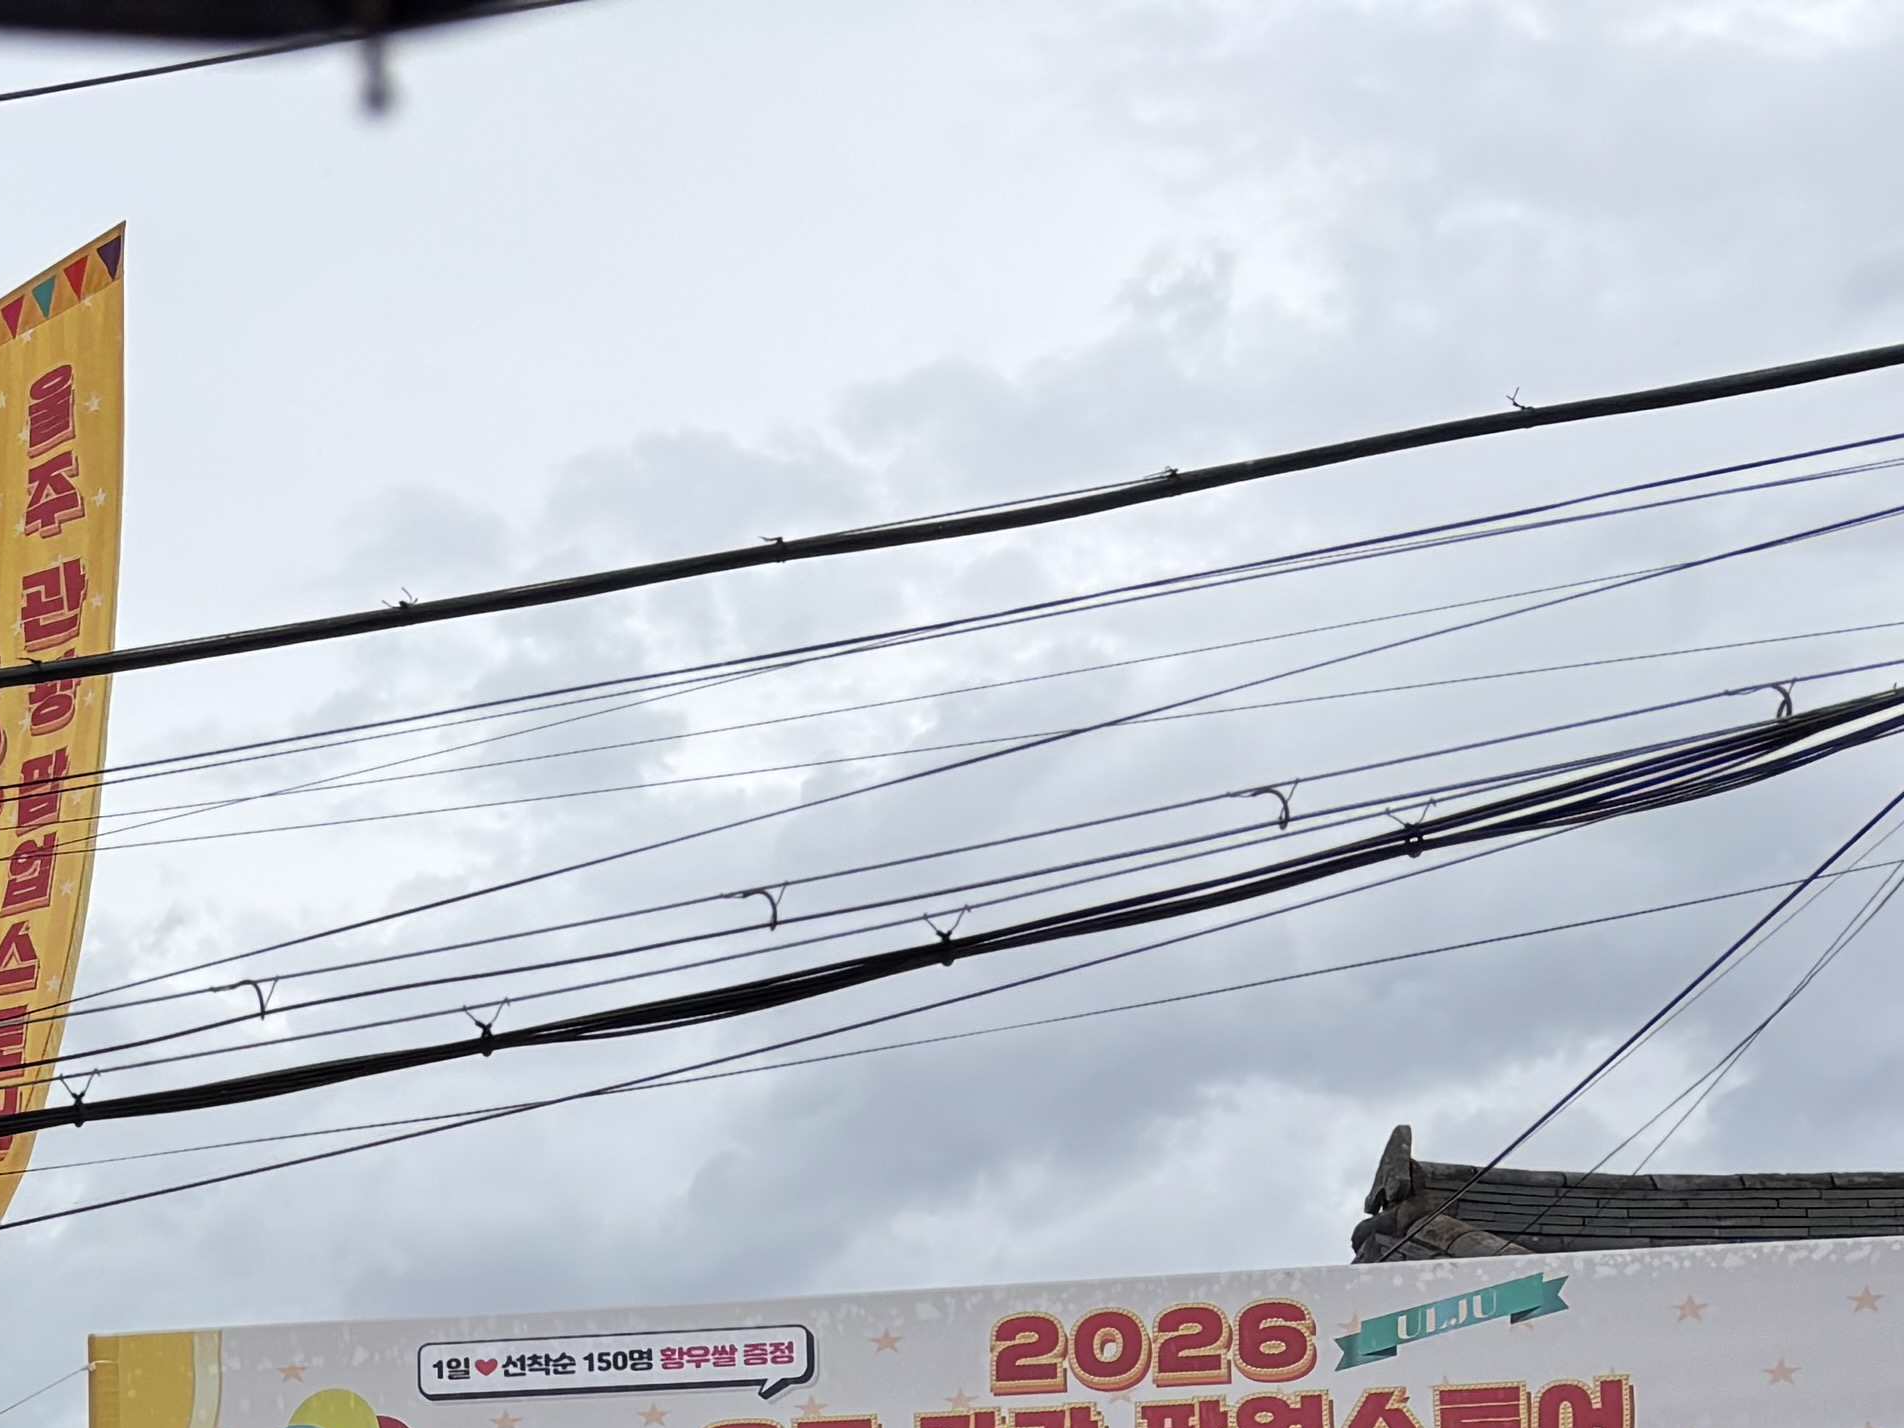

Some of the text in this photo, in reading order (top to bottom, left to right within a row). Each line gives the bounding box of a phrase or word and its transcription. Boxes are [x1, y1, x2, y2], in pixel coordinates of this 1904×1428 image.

[432, 1340, 796, 1380] 1일 선착순 150명 황우쌀 증정
[990, 1297, 1319, 1397] 2026
